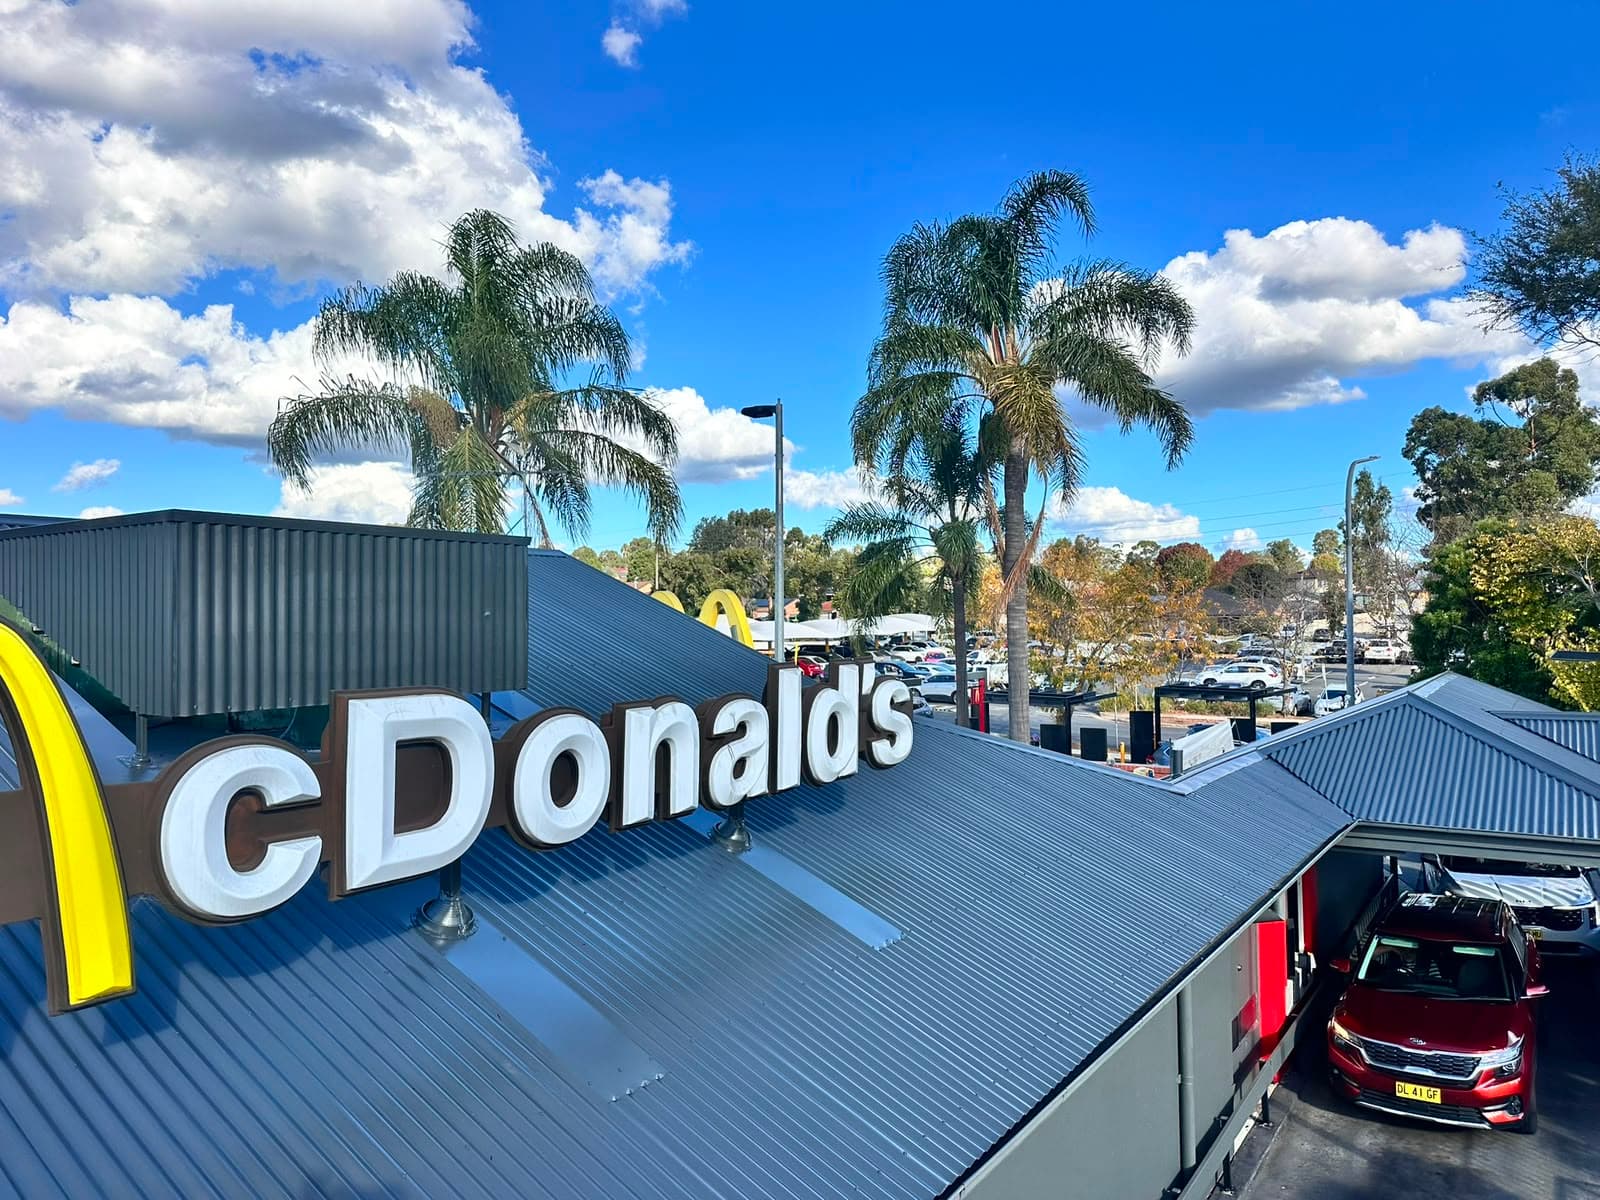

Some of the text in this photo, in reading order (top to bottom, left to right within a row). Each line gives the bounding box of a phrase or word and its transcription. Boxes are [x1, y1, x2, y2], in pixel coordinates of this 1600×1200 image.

[1397, 1083, 1438, 1100] DL 41 GF
